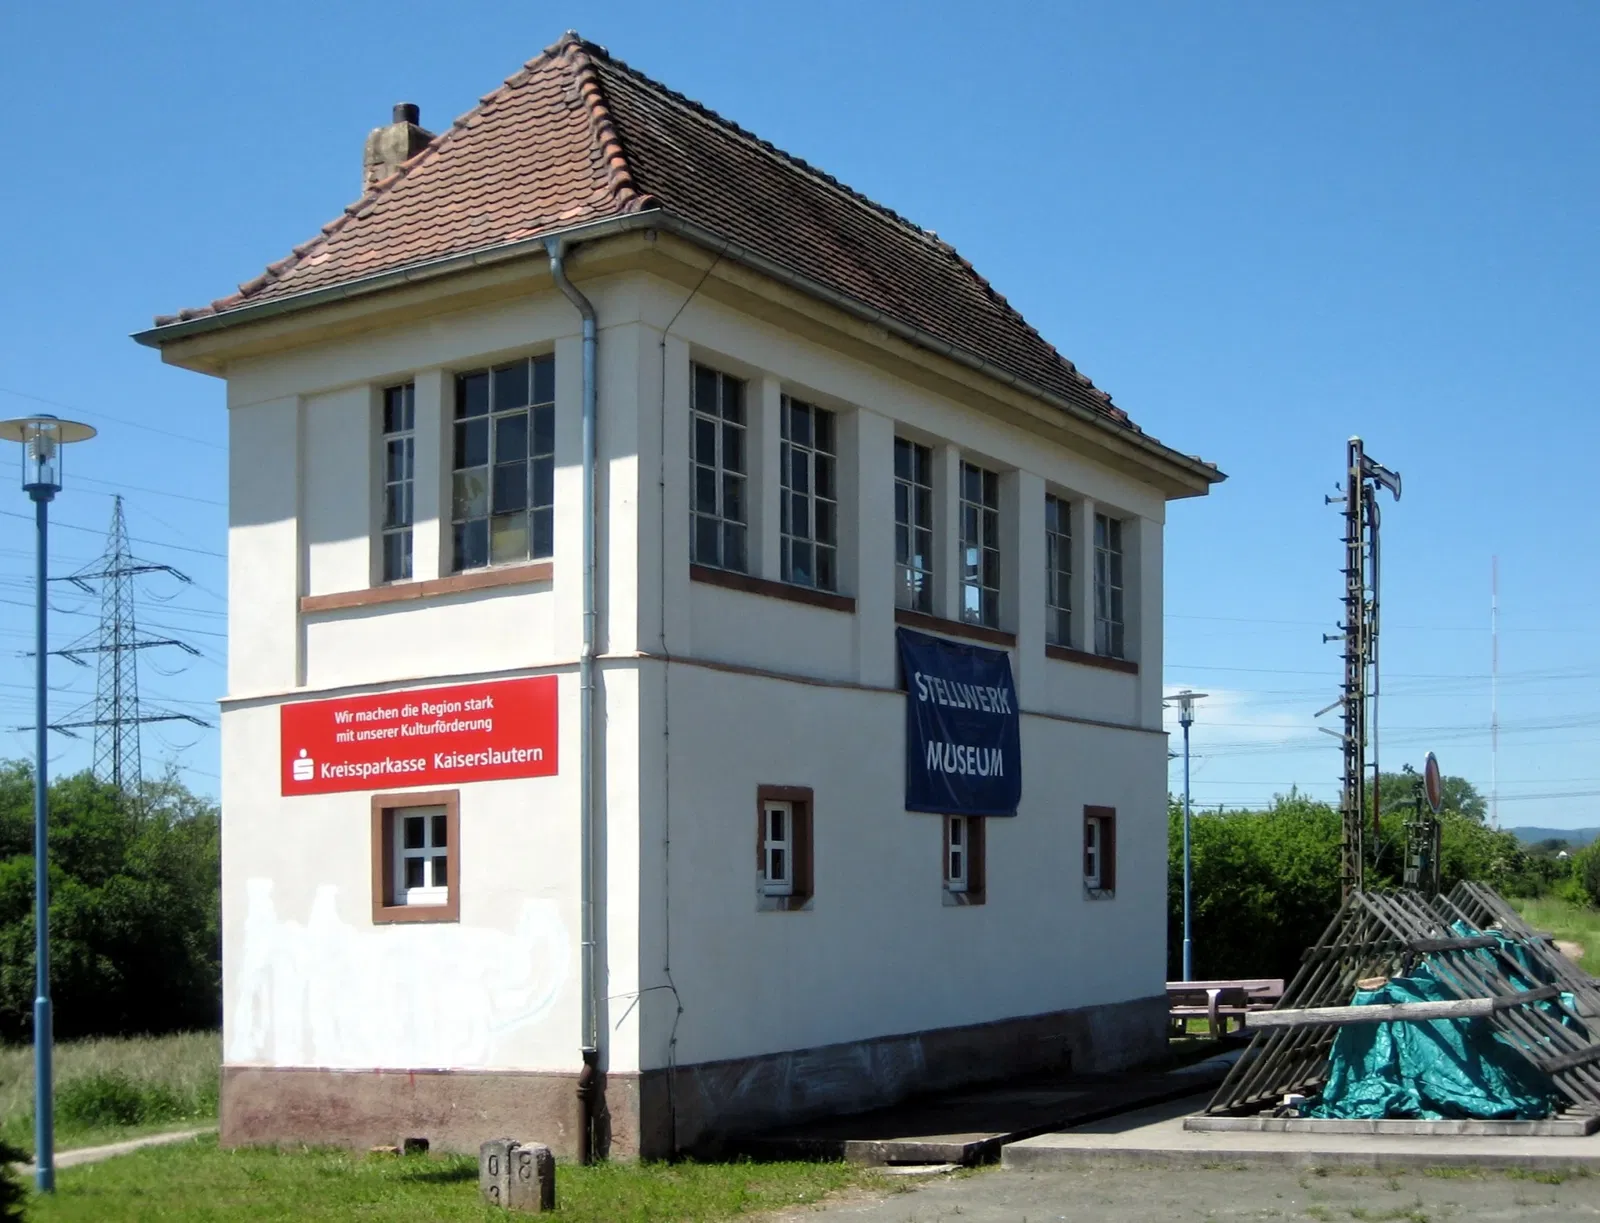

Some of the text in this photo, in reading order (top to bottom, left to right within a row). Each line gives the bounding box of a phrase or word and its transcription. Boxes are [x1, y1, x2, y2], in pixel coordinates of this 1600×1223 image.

[914, 671, 1011, 714] STELLWERK
[335, 696, 494, 724] Wir machen die Region stark
[336, 718, 492, 743] mit unserer Kulturförderung
[321, 747, 543, 779] Kreissparkasse Kaiserslautern
[927, 740, 1003, 777] MUSEUM
